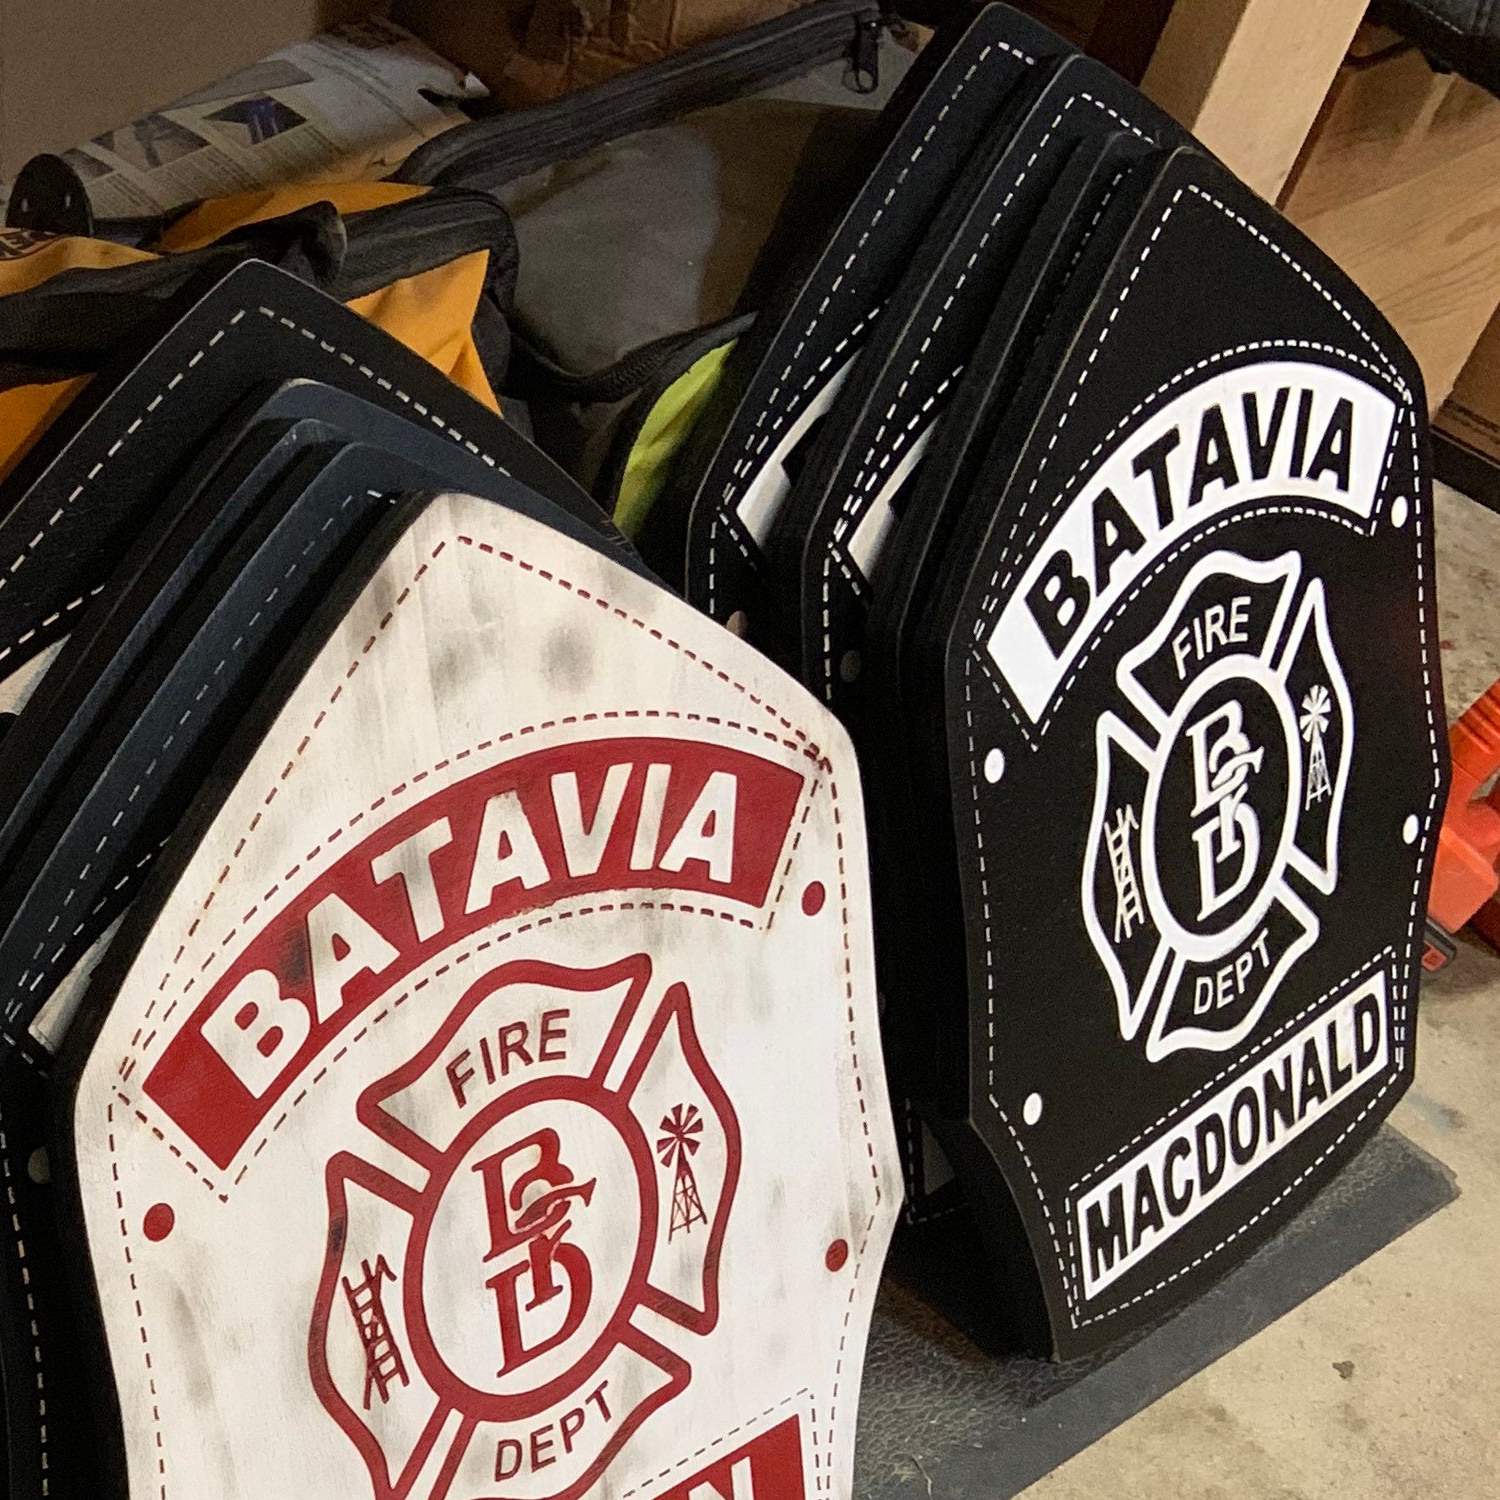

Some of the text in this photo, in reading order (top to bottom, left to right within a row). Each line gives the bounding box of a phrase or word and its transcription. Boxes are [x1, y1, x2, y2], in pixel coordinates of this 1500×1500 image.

[1024, 386, 1355, 655] BATAVIA
[1172, 596, 1251, 681] FIRE
[201, 762, 739, 1100] BATAVIA
[1192, 929, 1272, 1017] DEPT
[445, 1008, 571, 1108] FIRE
[1085, 991, 1381, 1283] MACDONALD
[494, 1380, 614, 1483] DEPT
